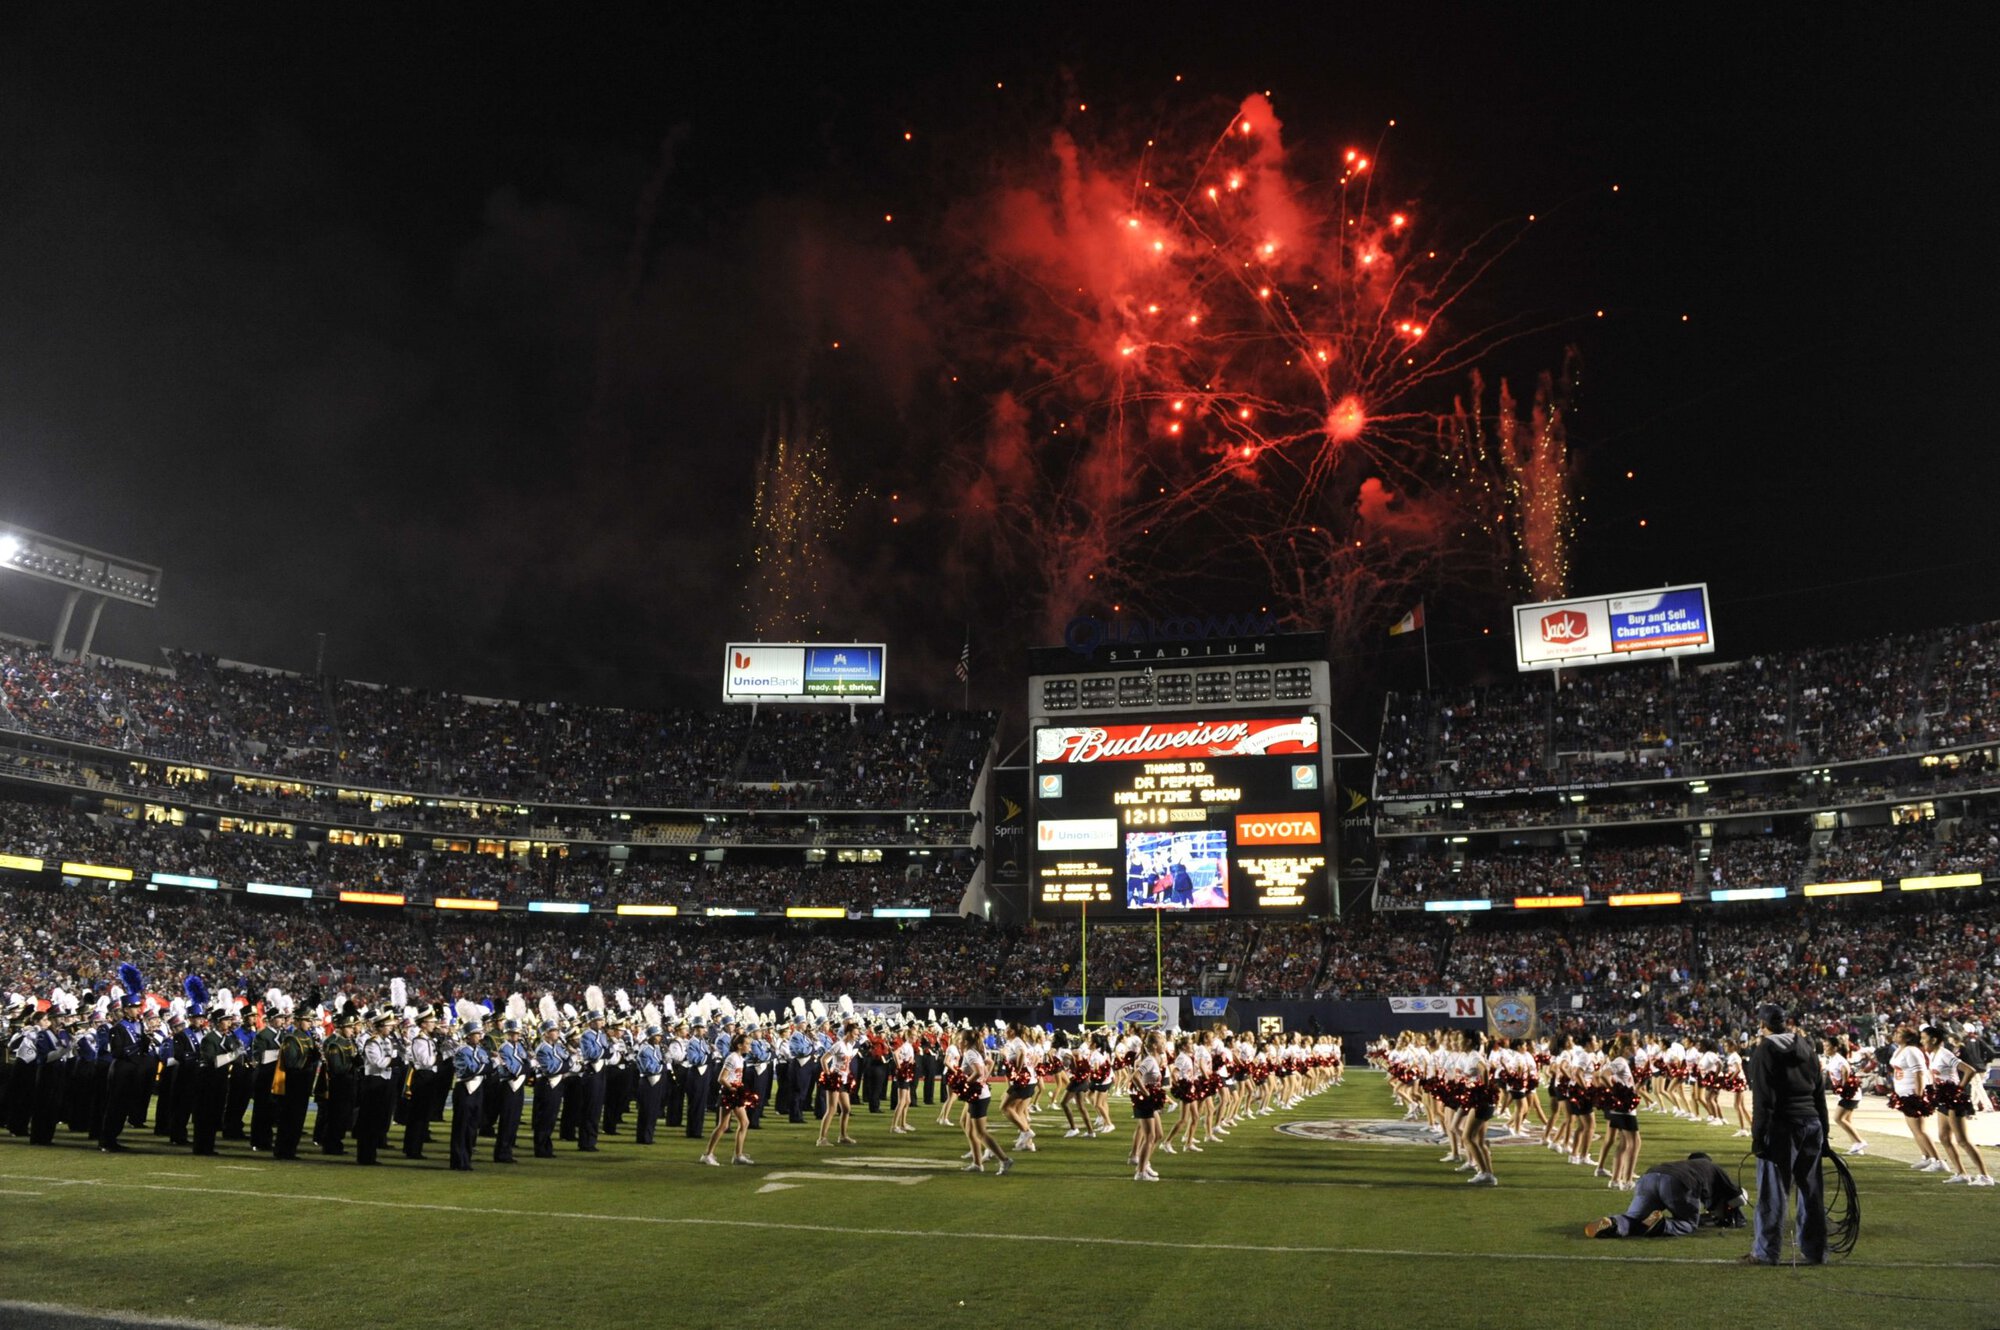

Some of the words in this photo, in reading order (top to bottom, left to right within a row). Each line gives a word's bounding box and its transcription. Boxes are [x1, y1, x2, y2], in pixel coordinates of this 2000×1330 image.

[1627, 614, 1646, 625] Buy
[1647, 611, 1666, 623] and
[1667, 609, 1686, 621] Sell
[1543, 613, 1587, 641] Jack
[1616, 625, 1661, 638] Chargers
[1661, 619, 1700, 633] Tickets!
[1065, 612, 1280, 660] QUALCOMM
[1109, 642, 1266, 660] STADIUM
[733, 676, 800, 687] UnionBank
[808, 684, 832, 693] ready.
[1063, 721, 1250, 763] Budweiser
[1144, 763, 1186, 774] THANKS
[1189, 762, 1205, 773] TO
[1135, 777, 1155, 789] DR
[1160, 775, 1215, 788] PEPPER
[1114, 790, 1193, 804] HALFTIME
[1200, 788, 1241, 801] SHOW
[1240, 821, 1317, 837] TOYOTA
[1339, 816, 1372, 828] Sprint
[995, 825, 1025, 838] Sprint
[1122, 1002, 1147, 1014] PACIFIC
[1455, 998, 1476, 1016] N
[1260, 1017, 1280, 1033] 25
